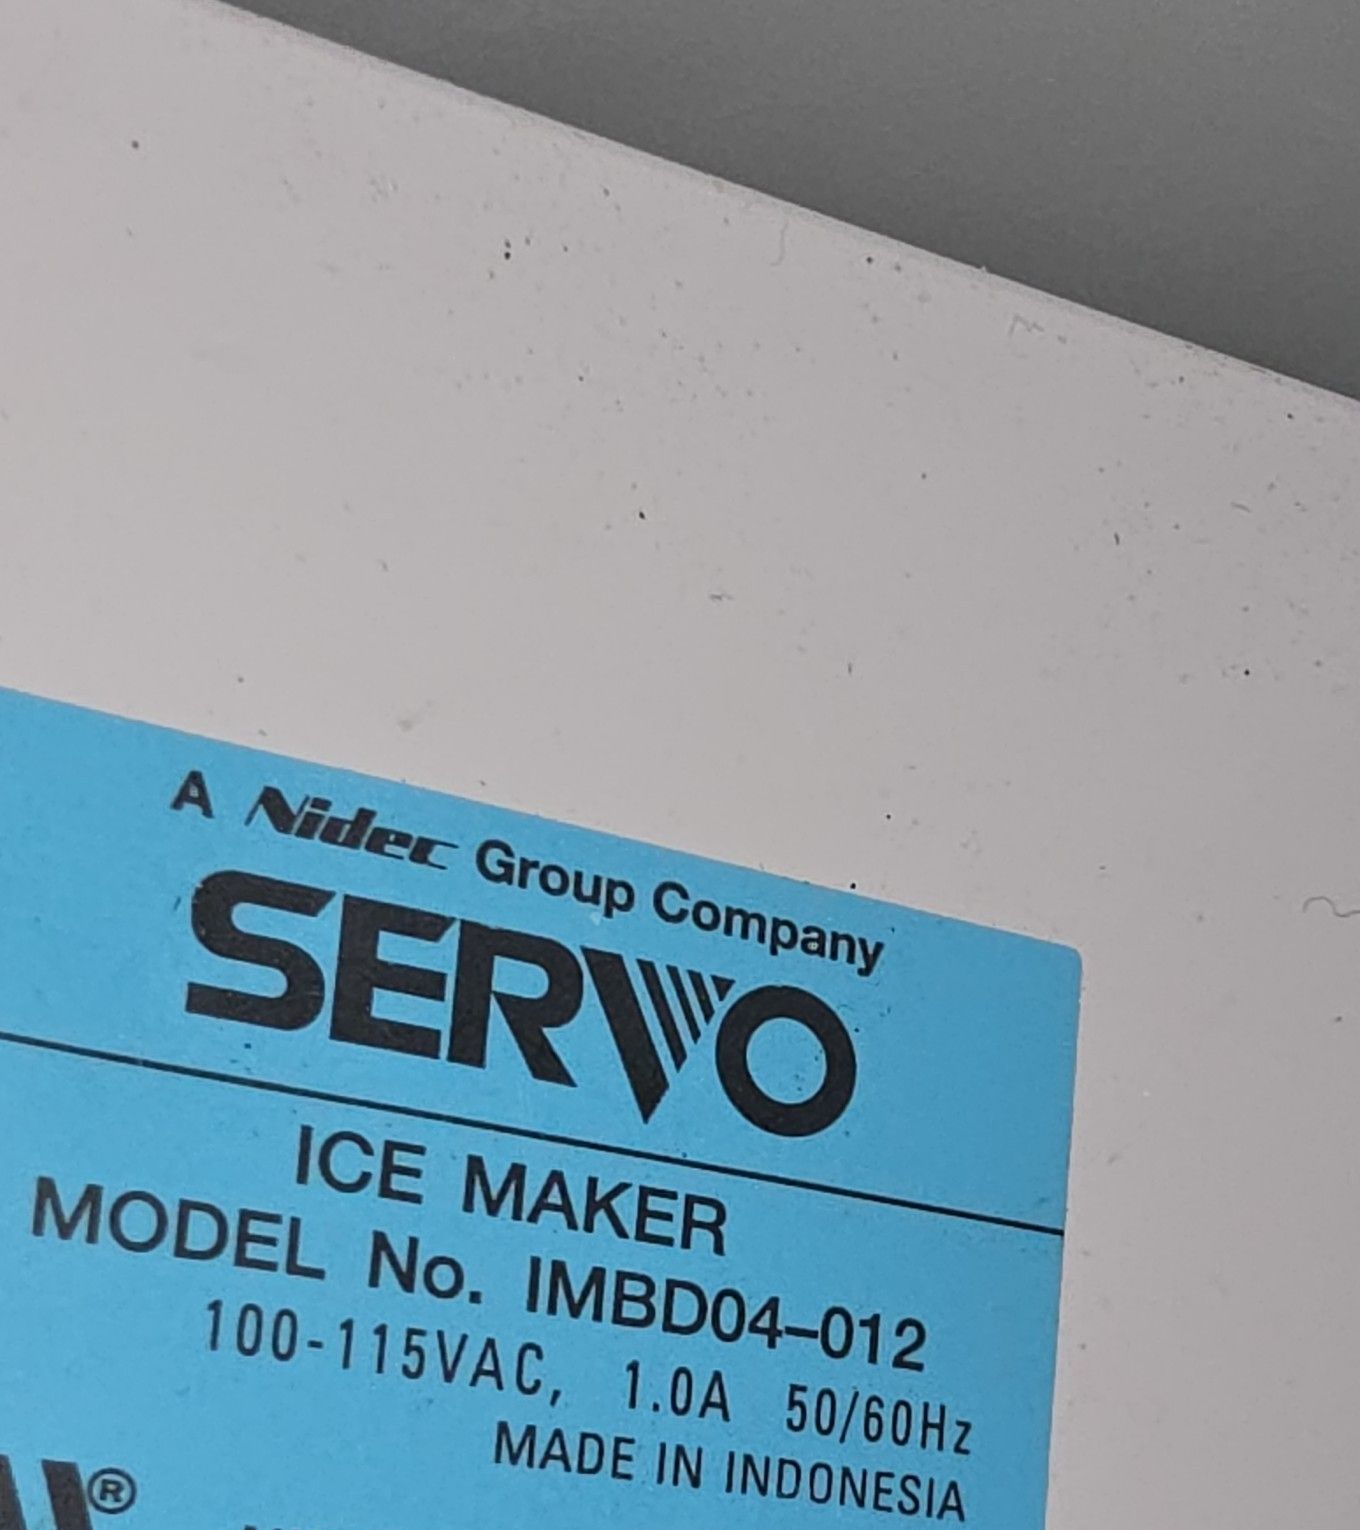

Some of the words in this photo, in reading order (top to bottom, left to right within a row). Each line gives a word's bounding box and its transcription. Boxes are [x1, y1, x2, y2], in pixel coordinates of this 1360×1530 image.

[170, 769, 214, 820] A
[244, 785, 460, 871] Nidec
[474, 838, 636, 920] Group
[652, 880, 886, 978] Company
[184, 869, 858, 1139] SERVO
[31, 1175, 327, 1281] MODEL
[367, 1229, 483, 1306] No.
[525, 1254, 927, 1374] IMBD04-012
[295, 1123, 428, 1206] ICE
[461, 1153, 728, 1258] MAKER
[206, 1298, 562, 1408] 100-115VAC,
[625, 1359, 732, 1424] 1.0A
[785, 1382, 973, 1457] 50/60Hz
[493, 1419, 637, 1482] MADE
[655, 1441, 704, 1490] IN
[724, 1449, 966, 1524] INDONESIA
